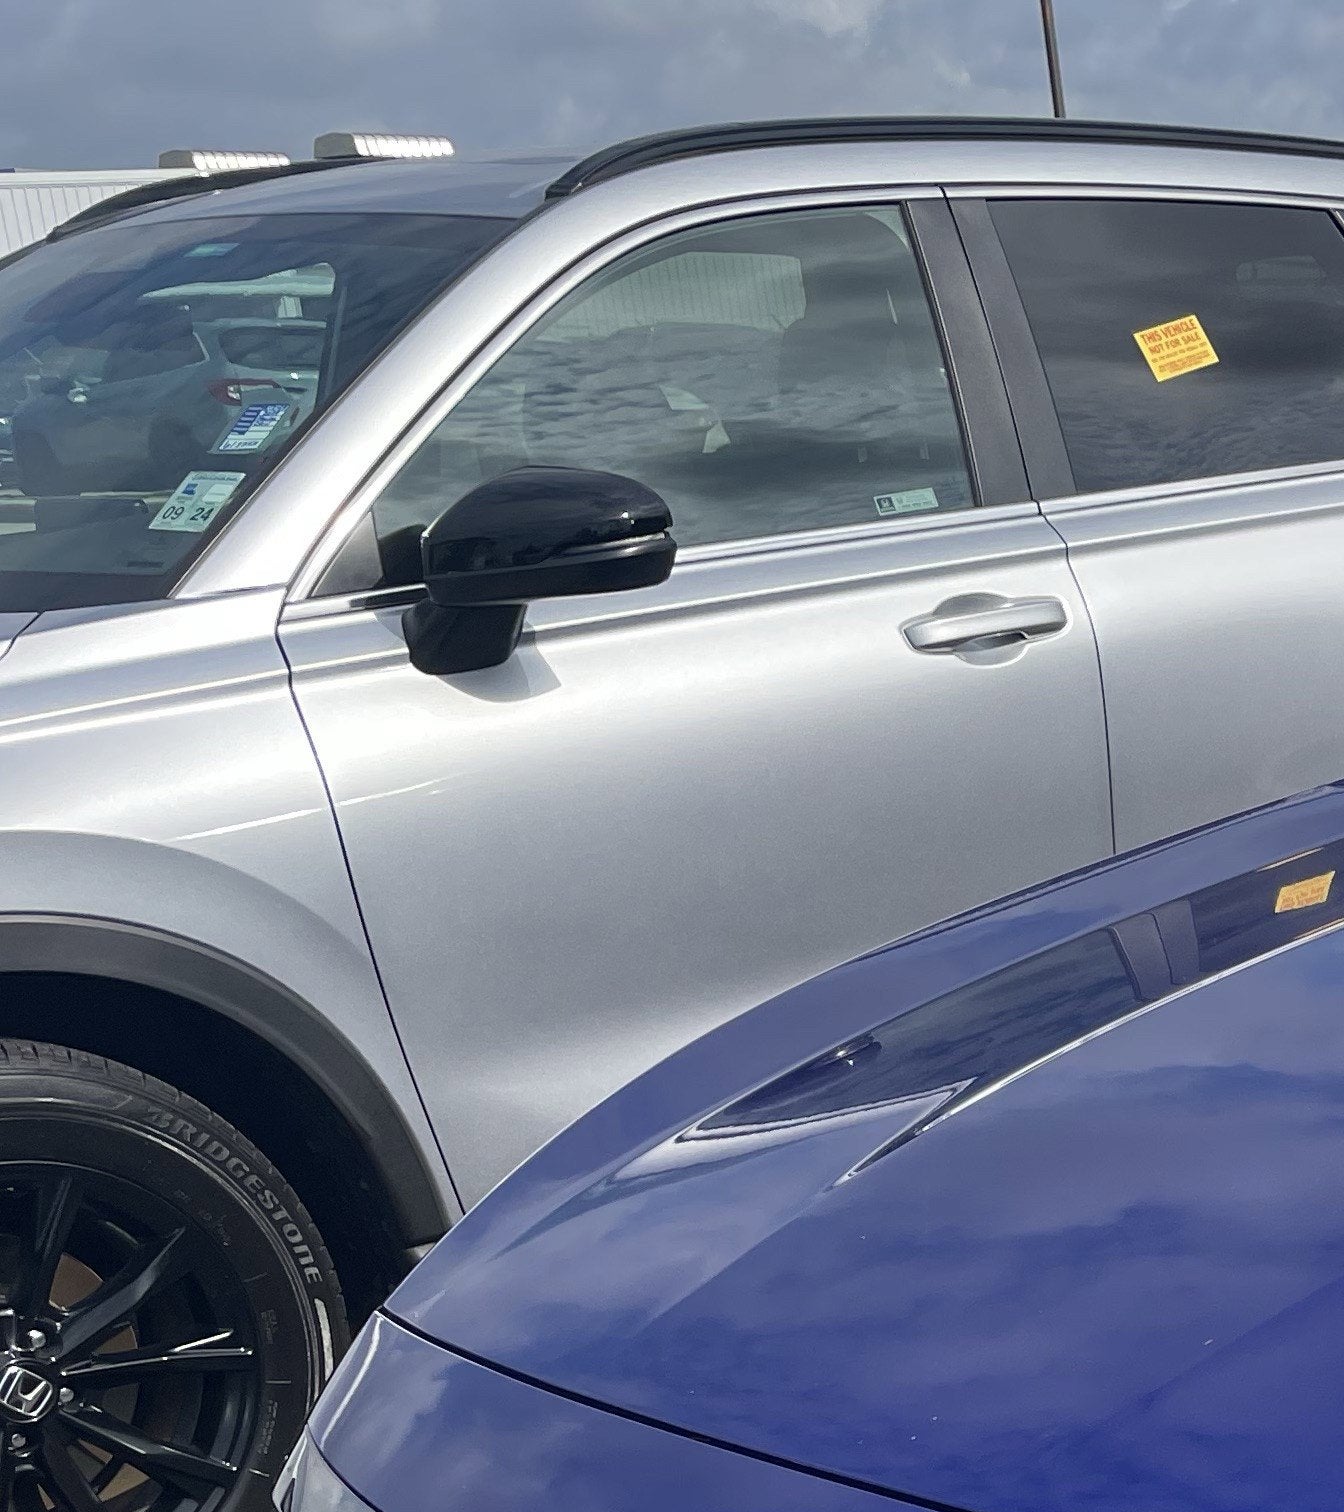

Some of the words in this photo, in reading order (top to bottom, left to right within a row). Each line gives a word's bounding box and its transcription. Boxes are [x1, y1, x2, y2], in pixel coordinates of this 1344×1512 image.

[1139, 330, 1163, 346] THIS
[1161, 318, 1197, 340] VEHICLE
[1148, 344, 1165, 355] NOT
[1165, 338, 1181, 350] FOR
[1181, 331, 1201, 345] SALE
[162, 506, 185, 521] 09
[189, 507, 215, 521] 24
[144, 1106, 324, 1284] BRIDGESTONE
